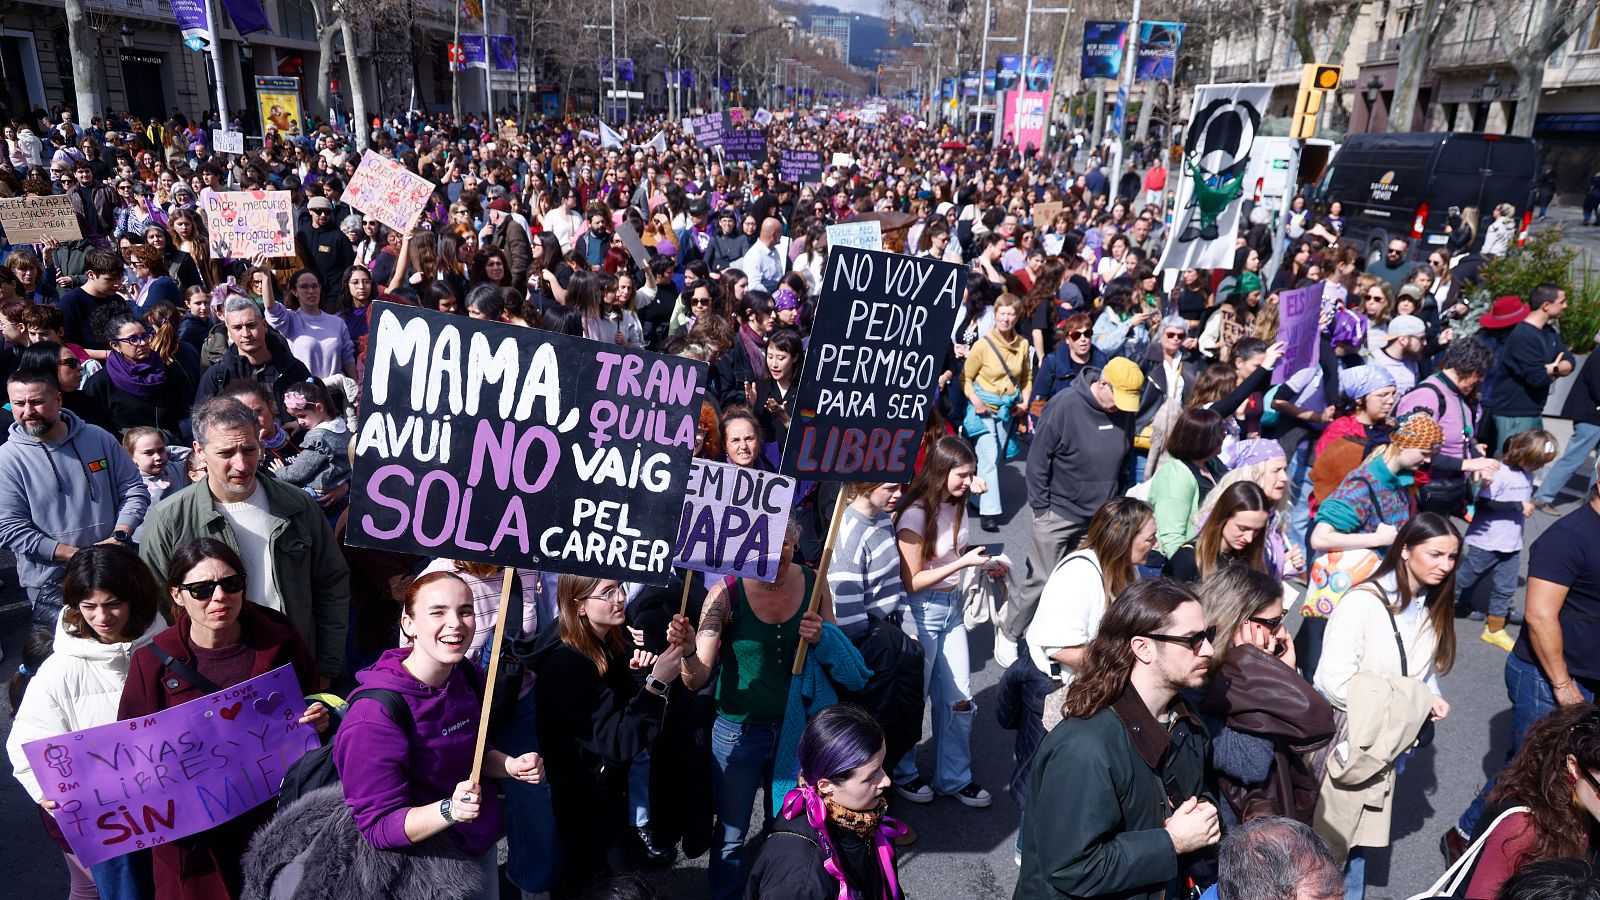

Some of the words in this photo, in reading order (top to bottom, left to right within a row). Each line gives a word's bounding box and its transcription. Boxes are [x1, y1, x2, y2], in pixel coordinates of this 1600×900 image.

[63, 197, 71, 206] A
[209, 197, 235, 211] Dice
[243, 200, 287, 211] mercurio
[0, 212, 17, 220] LOS
[21, 209, 55, 220] MACHOS
[213, 217, 233, 232] que
[238, 216, 247, 226] el
[859, 226, 874, 234] NO
[833, 253, 874, 292] NO
[885, 257, 934, 300] VOY
[934, 268, 958, 308] A
[846, 300, 928, 346] PEDIR
[371, 309, 579, 433] MAMA,
[815, 344, 934, 390] PERMISO
[595, 352, 706, 407] TRAN-
[816, 389, 876, 418] PARA
[887, 394, 928, 421] SER
[467, 419, 561, 494] NO
[796, 425, 916, 475] LIBRE
[362, 465, 530, 554] SOLA
[573, 498, 641, 538] PEL
[540, 527, 669, 573] CARRER
[224, 684, 254, 701] LOVE
[242, 690, 258, 701] ME
[130, 722, 137, 730] 8
[144, 718, 156, 728] M
[284, 708, 295, 720] 8
[248, 723, 270, 752] Y
[286, 721, 299, 733] M
[58, 781, 80, 794] 8M
[136, 840, 145, 848] 8
[152, 836, 165, 845] M
